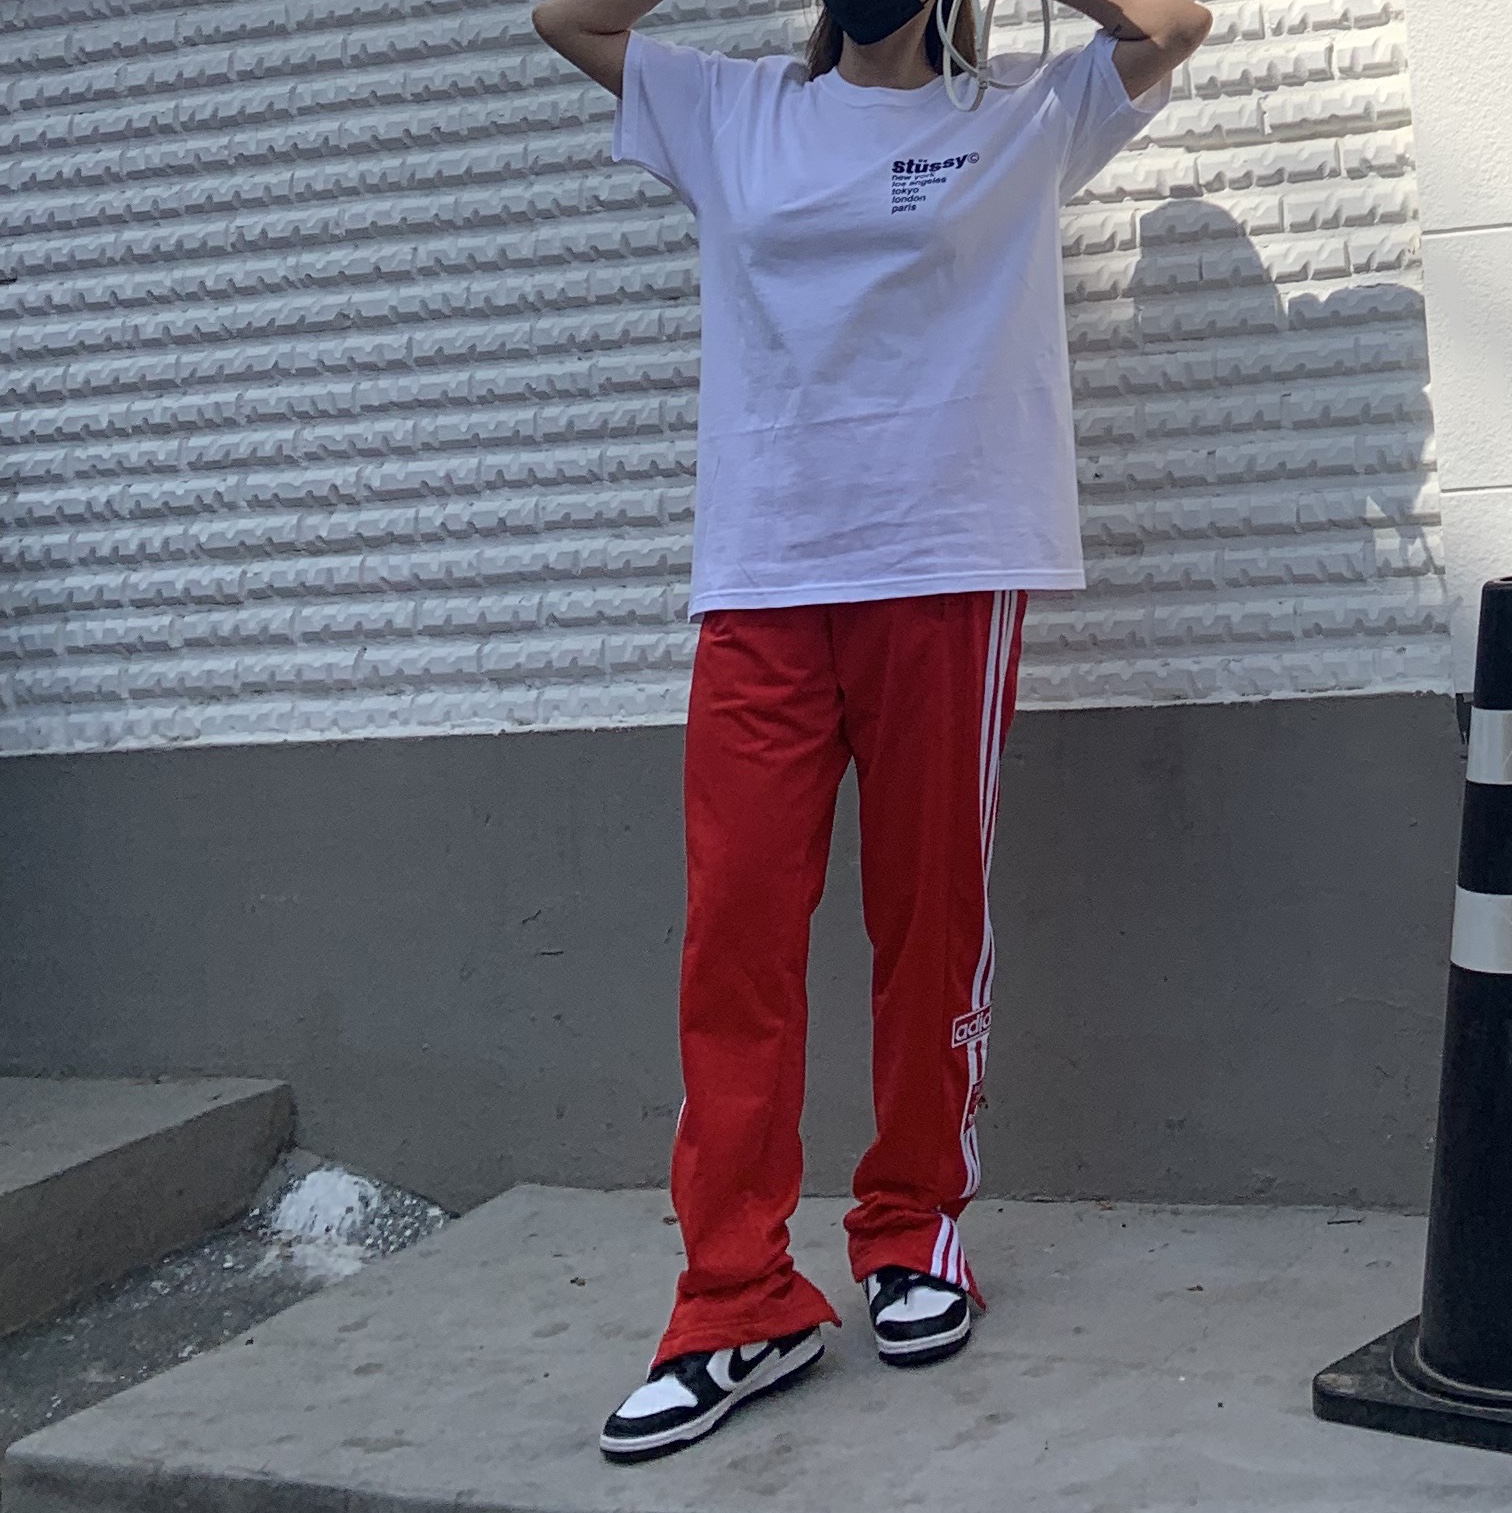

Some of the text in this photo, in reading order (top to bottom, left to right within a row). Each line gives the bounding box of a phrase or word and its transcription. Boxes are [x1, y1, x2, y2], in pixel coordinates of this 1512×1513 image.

[914, 173, 935, 181] york
[909, 177, 947, 187] angeles
[891, 187, 920, 196] tokyo
[891, 195, 926, 204] london
[891, 204, 917, 215] paris
